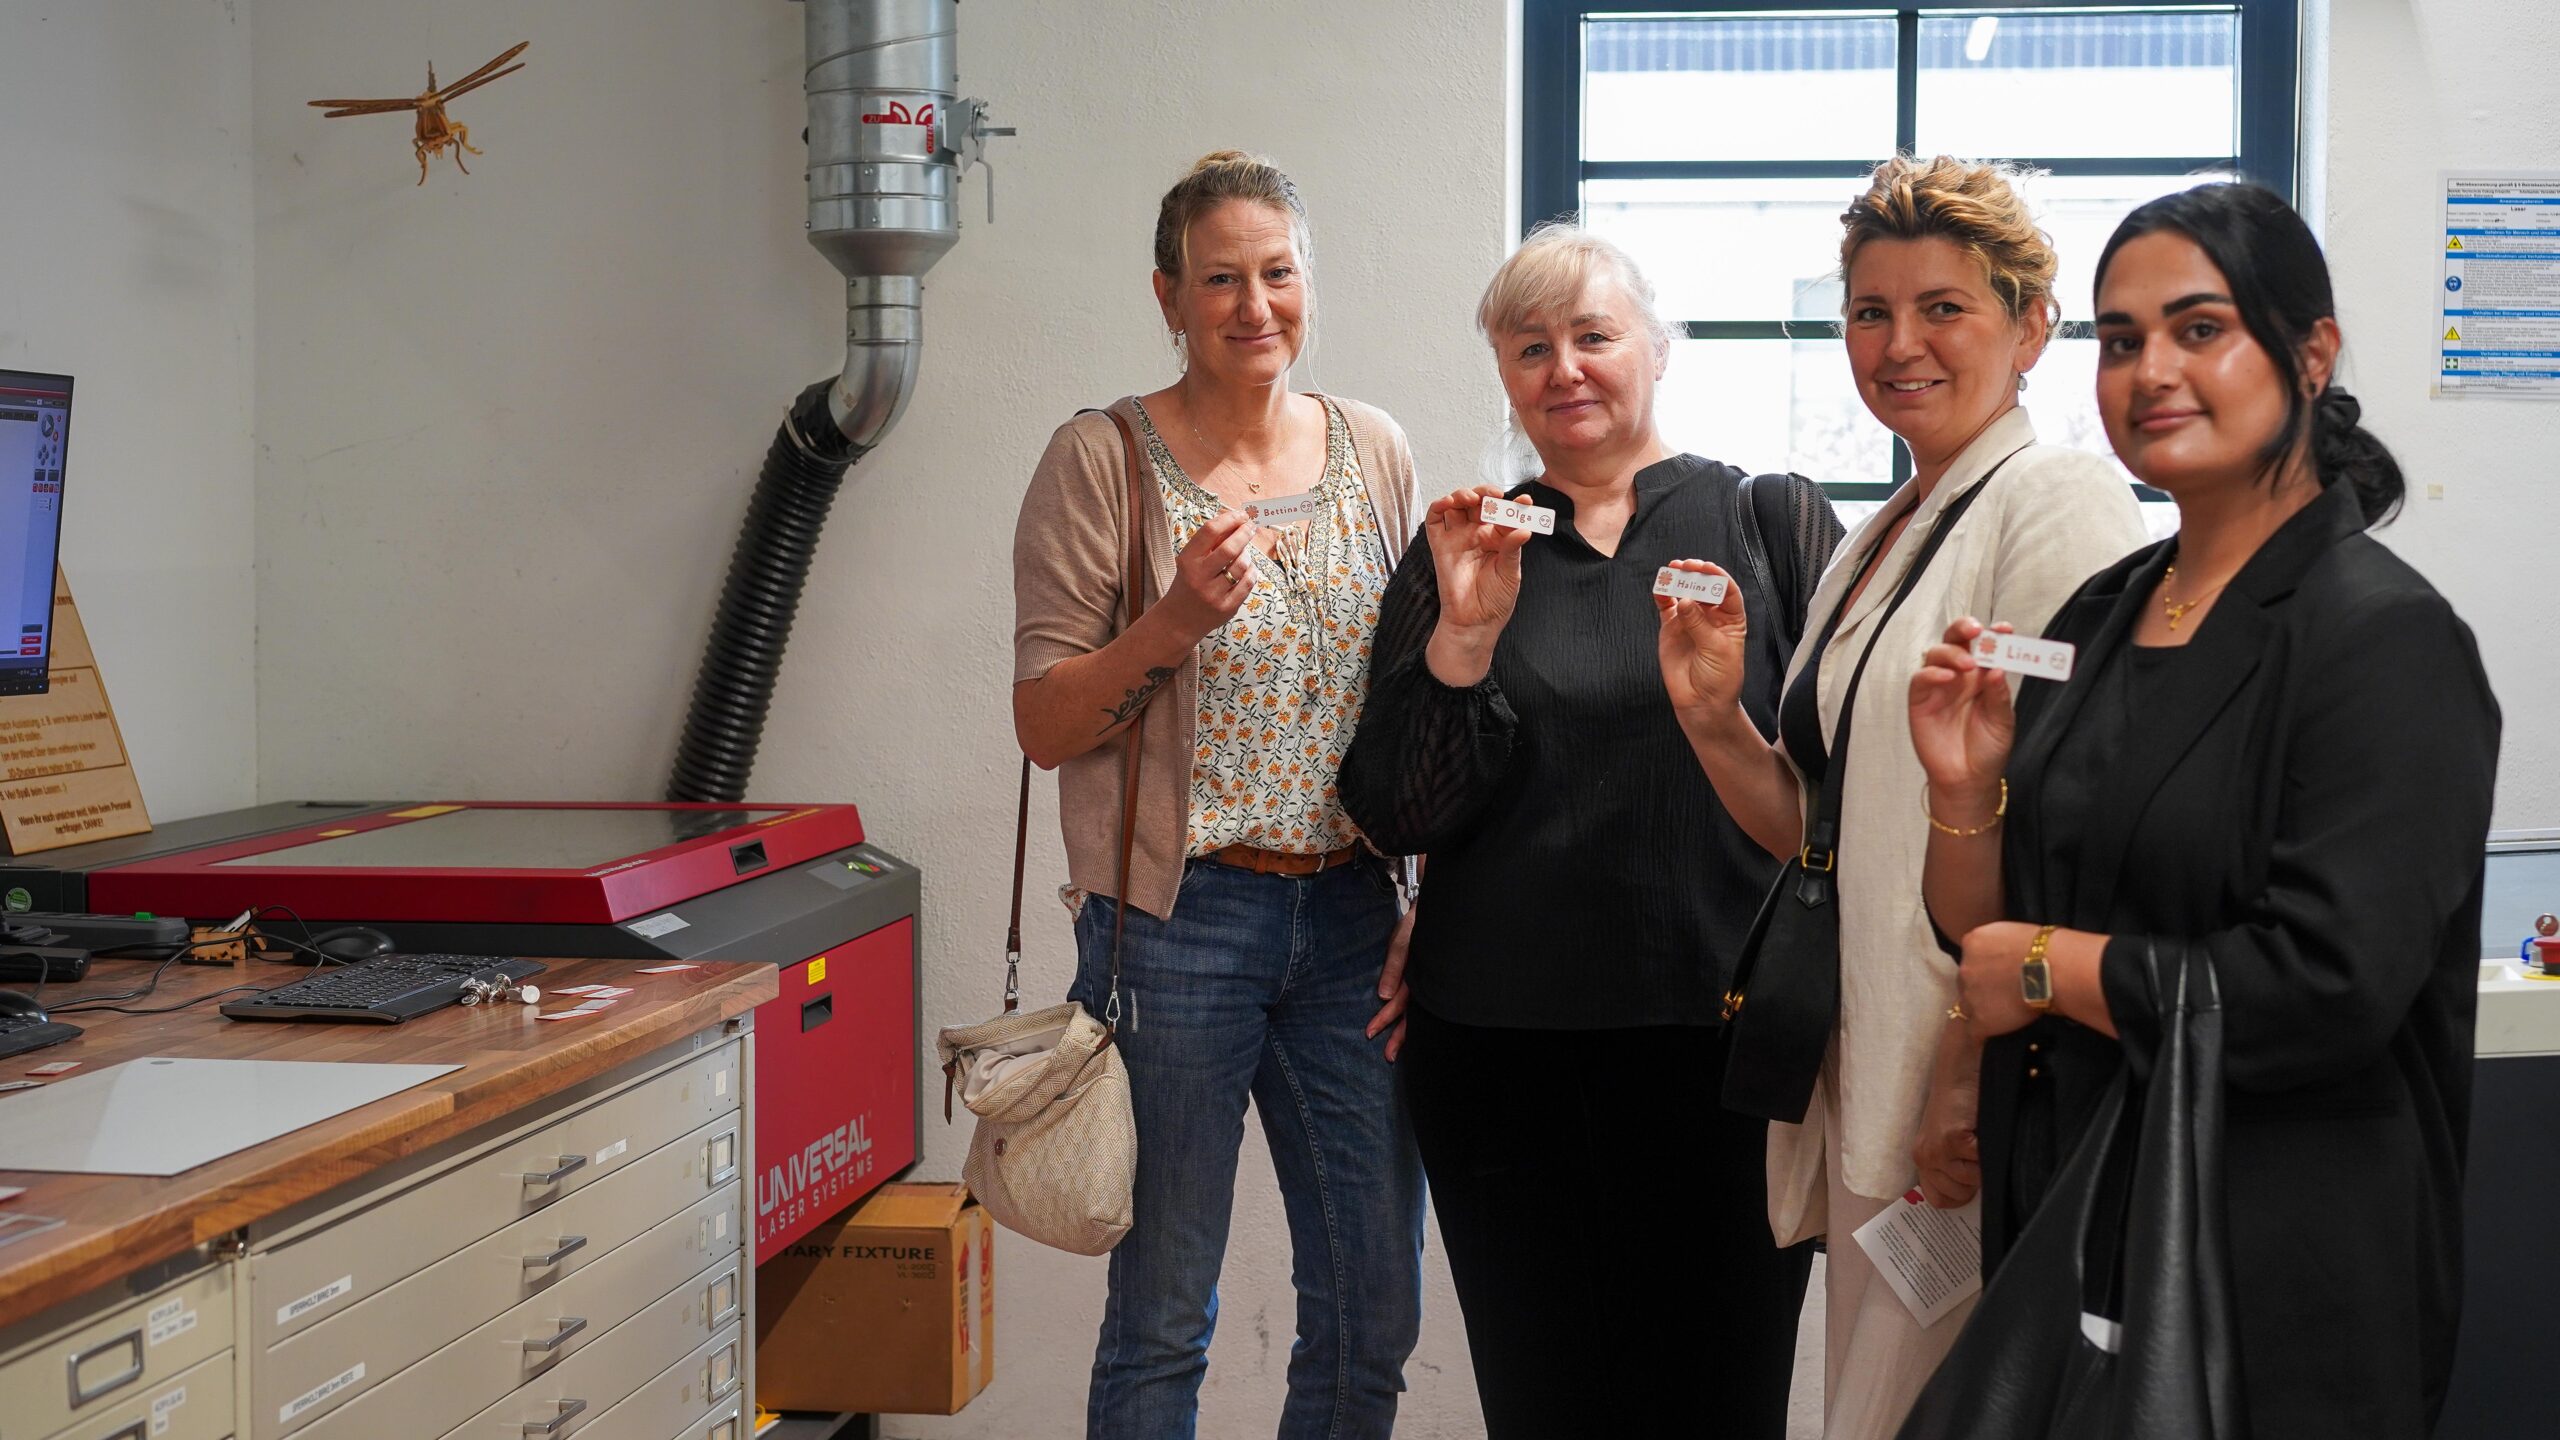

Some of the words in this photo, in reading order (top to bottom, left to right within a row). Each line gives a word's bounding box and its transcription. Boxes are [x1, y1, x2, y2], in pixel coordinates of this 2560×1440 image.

[1264, 506, 1298, 517] Bettina
[1506, 508, 1532, 524] Olga
[1677, 579, 1707, 592] Halina
[2005, 645, 2041, 664] Lina
[758, 1114, 872, 1217] UNIVERSAL
[759, 1197, 805, 1244] LASER
[813, 1154, 873, 1208] SYSTEMS
[843, 1246, 935, 1260] FIXTURE
